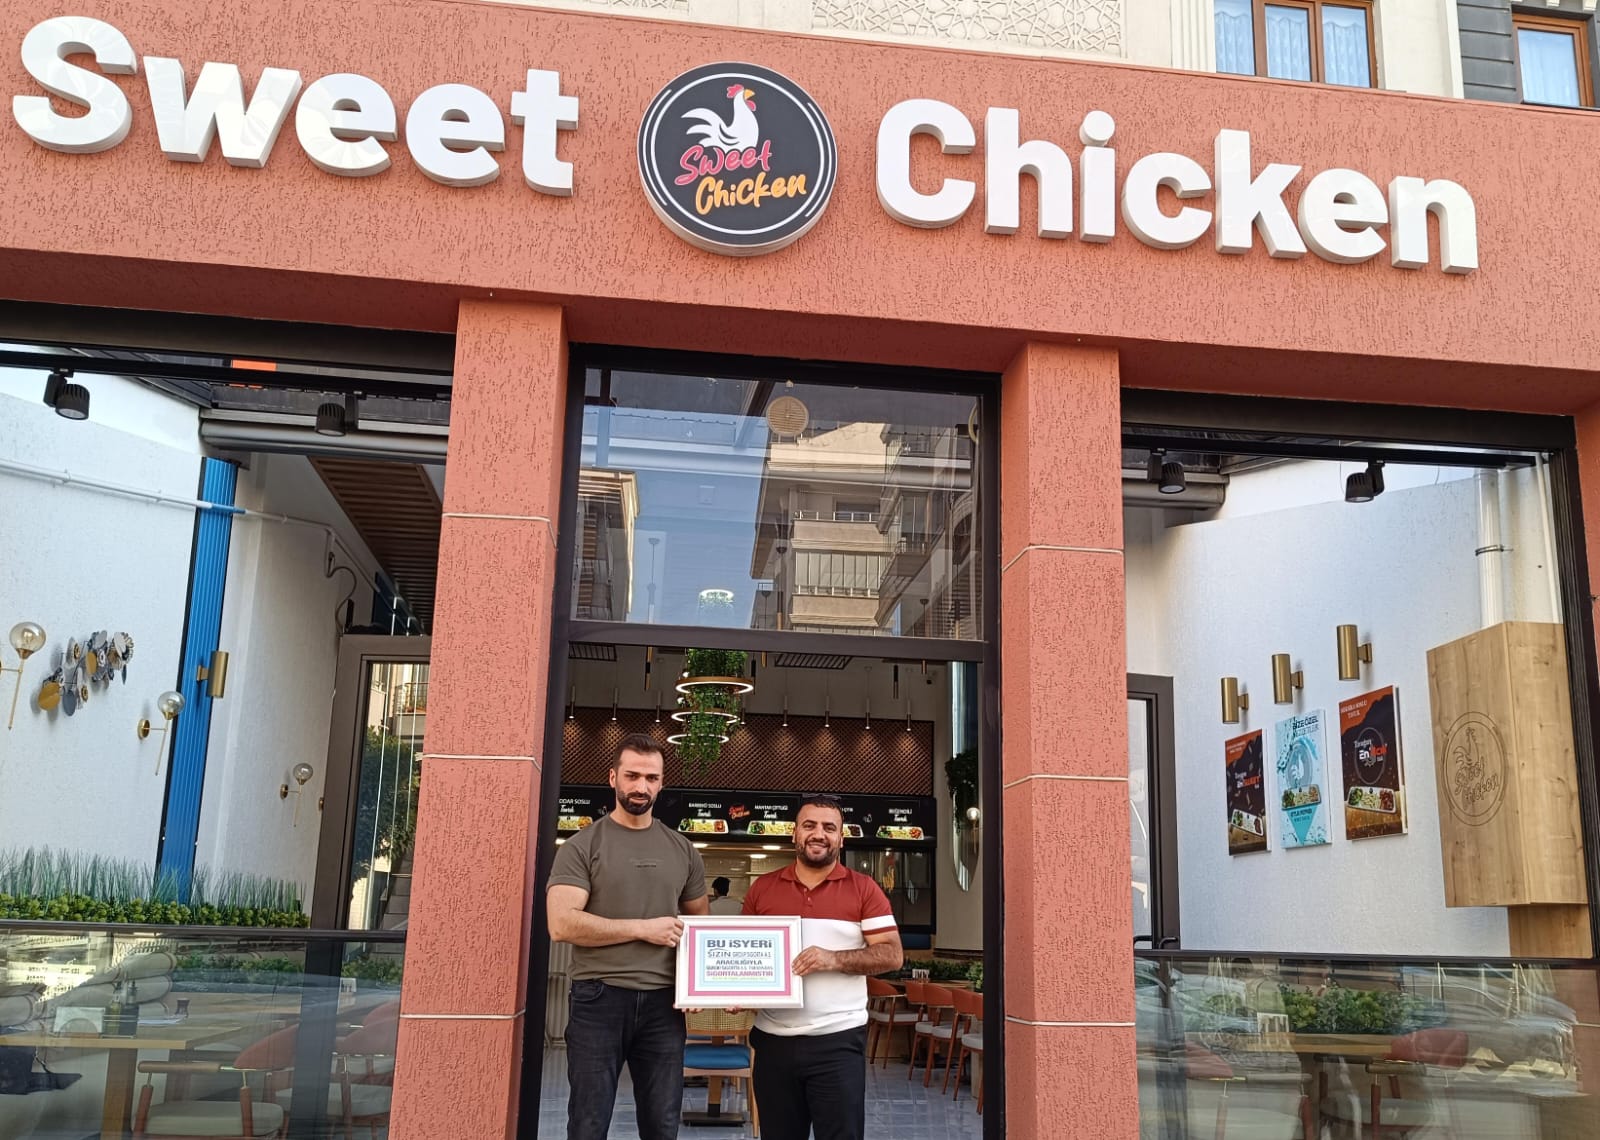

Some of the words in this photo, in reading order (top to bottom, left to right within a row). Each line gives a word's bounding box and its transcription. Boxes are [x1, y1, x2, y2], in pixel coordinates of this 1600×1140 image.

[12, 15, 580, 197] Sweet
[876, 98, 1480, 275] Chicken
[674, 139, 773, 186] Sweet
[706, 939, 726, 948] BU
